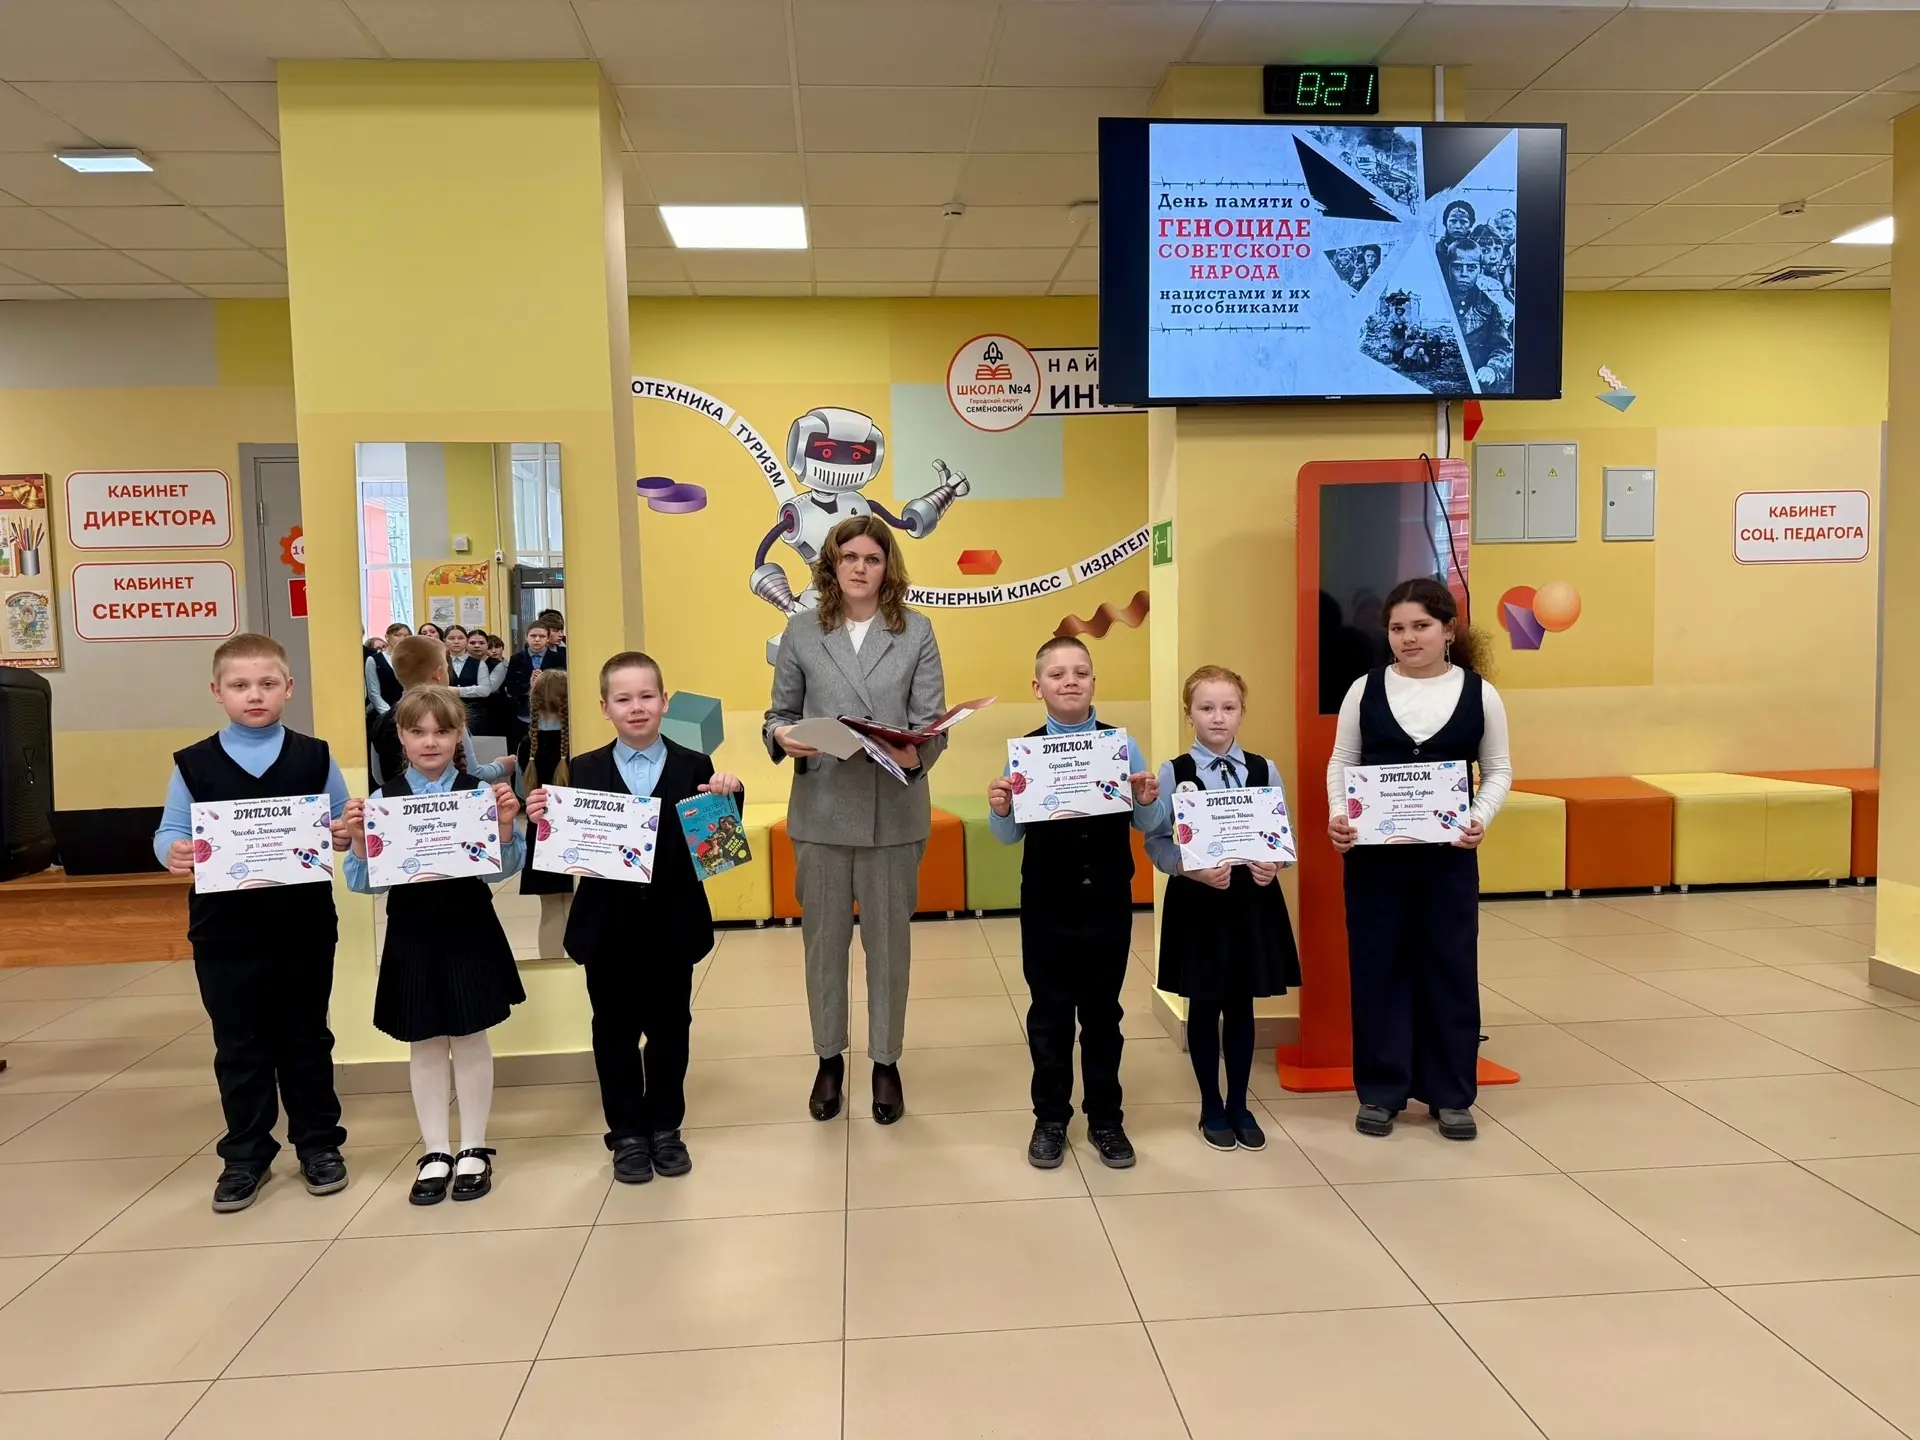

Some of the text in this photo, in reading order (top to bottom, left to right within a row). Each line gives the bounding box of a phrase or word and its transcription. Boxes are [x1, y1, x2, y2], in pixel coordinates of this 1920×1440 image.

[1296, 71, 1374, 106] 8:21
[1157, 193, 1311, 210] День памяти о
[1158, 218, 1311, 240] ГЕНОЦИДЕ
[1158, 243, 1311, 258] СОВЕТСКОГО
[1189, 264, 1280, 280] НАРОДА
[1160, 289, 1311, 301] нацистами и их
[1170, 300, 1299, 314] пособниками
[956, 383, 1031, 395] ШКОЛА №4
[966, 404, 1023, 413] СЕМЁНОВСКИЙ
[736, 423, 786, 488] ТУРИЗМ
[108, 484, 189, 498] КАБИНЕТ
[1769, 505, 1837, 518] КАБИНЕТ
[83, 509, 216, 530] ДИРЕКТОРА
[1740, 525, 1864, 543] СОЦ. ПЕДАГОГА
[114, 576, 194, 591] КАБИНЕТ
[1007, 575, 1062, 600] КЛАСС
[92, 601, 217, 620] СЕКРЕТАРЯ
[1043, 740, 1093, 754] ДИПЛОМ
[1380, 771, 1432, 783] ДИПЛОМ
[402, 800, 459, 815] ДИПЛОМ
[573, 798, 625, 813] ДИПЛОМ
[1206, 795, 1253, 807] ДИПЛОМ
[233, 805, 292, 820] ДИПЛОМ
